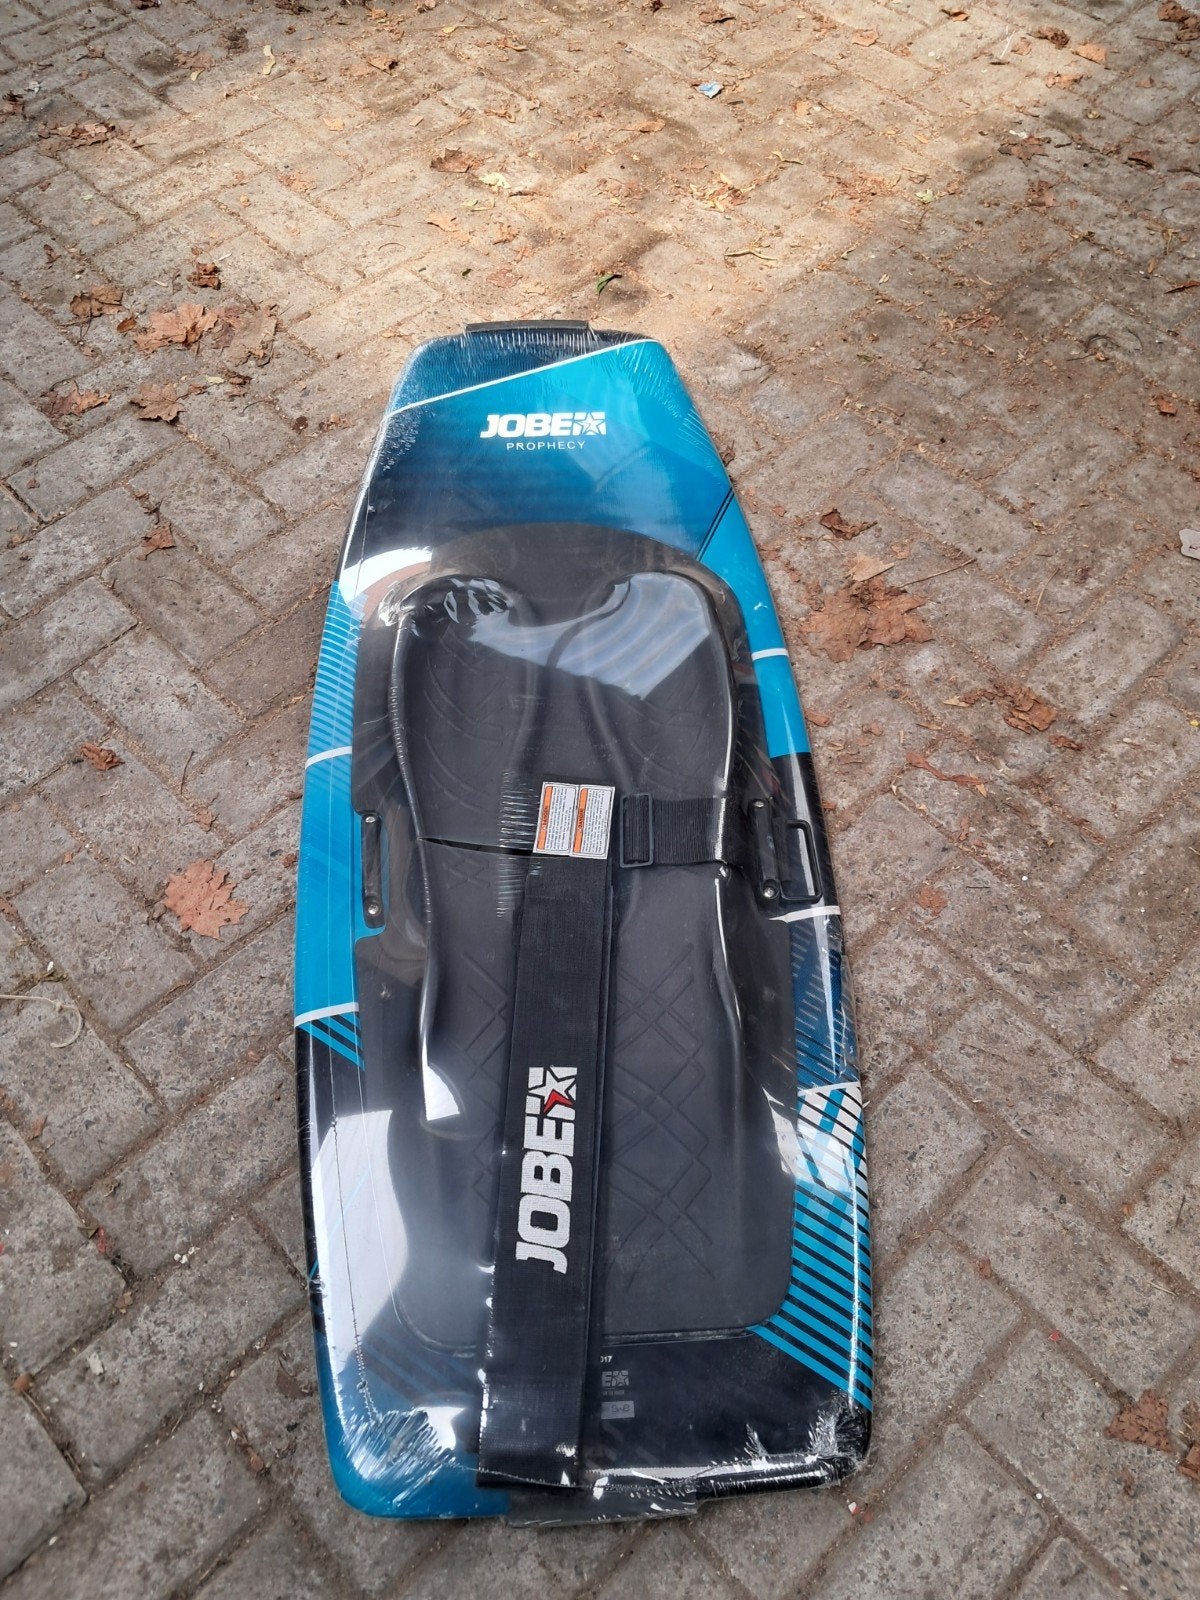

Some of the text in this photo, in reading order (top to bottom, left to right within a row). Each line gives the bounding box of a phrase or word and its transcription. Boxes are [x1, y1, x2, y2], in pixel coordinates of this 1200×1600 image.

[480, 412, 574, 438] JOBE
[506, 441, 585, 451] PROPHECY
[515, 1115, 575, 1275] JOBE
